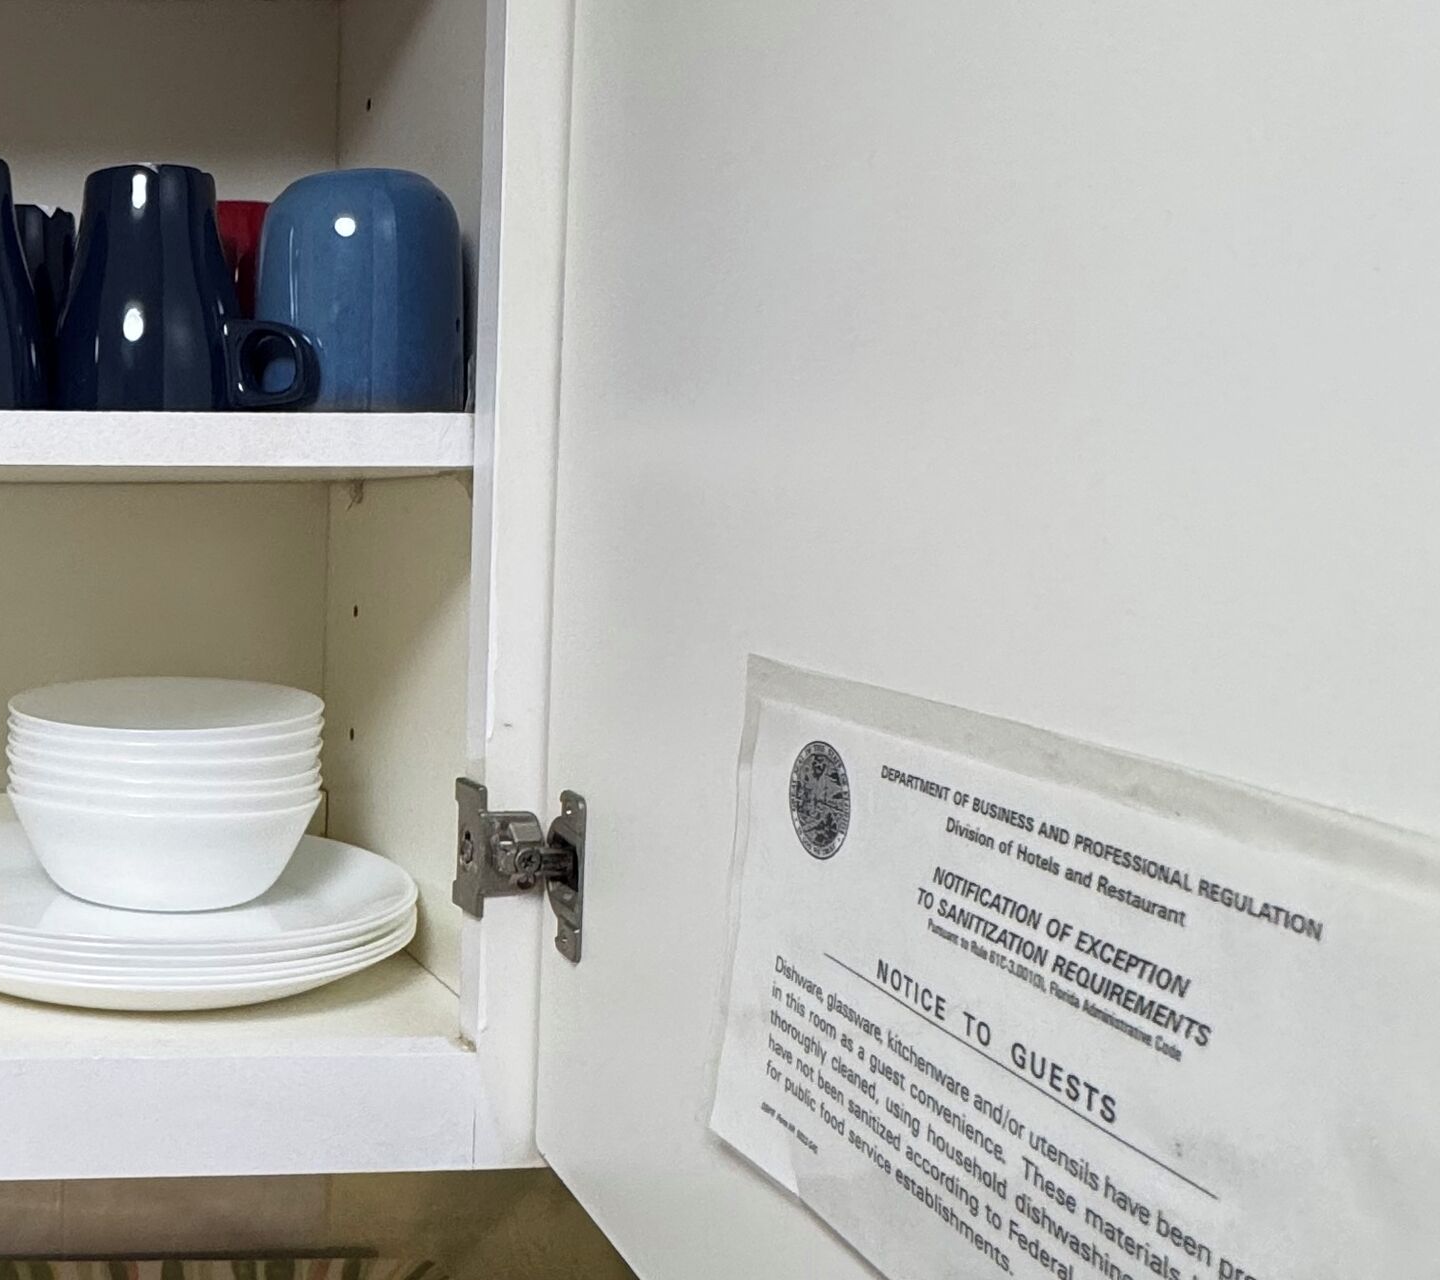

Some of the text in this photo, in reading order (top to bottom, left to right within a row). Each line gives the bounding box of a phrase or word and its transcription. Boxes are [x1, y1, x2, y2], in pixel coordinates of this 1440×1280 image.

[881, 765, 1323, 942] DEPARTMENT OF BUSINESS AND PROFESSIONAL REGULATION
[932, 867, 1191, 998] NOTIFICATION OF EXCEPTION
[945, 817, 1187, 928] Division of Hotels and Restaurant
[876, 959, 1117, 1124] NOTICE TO GUESTS
[917, 887, 1211, 1047] TO SANITIZATION REQUIREMENTS
[766, 1059, 782, 1083] for
[784, 1073, 817, 1112] public
[820, 1102, 845, 1136] food
[848, 1130, 892, 1174] service
[895, 1168, 1014, 1276] establishments.
[768, 1033, 793, 1064] have
[796, 1057, 814, 1082] not
[817, 1070, 844, 1106] been
[847, 1099, 902, 1152] sanitized
[905, 1144, 979, 1217] according
[985, 1204, 1002, 1231] to
[770, 1009, 827, 1065] thoroughly
[831, 1055, 880, 1104] cleaned,
[885, 1096, 921, 1138] using
[927, 1124, 1008, 1200] household
[772, 980, 782, 1001] in
[785, 992, 806, 1018] this
[809, 1010, 837, 1040] room
[841, 1033, 853, 1053] as
[858, 1046, 865, 1060] a
[869, 1054, 906, 1092] guest
[910, 1083, 1006, 1164] convenience.
[1022, 1156, 1076, 1214] These
[775, 955, 824, 1003] Dishware,
[826, 993, 884, 1044] glassware,
[886, 1030, 970, 1102] kitchenware
[973, 1094, 1026, 1139] and/or
[1029, 1131, 1099, 1191] utensils
[1104, 1175, 1150, 1225] have
[1156, 1209, 1212, 1268] been
